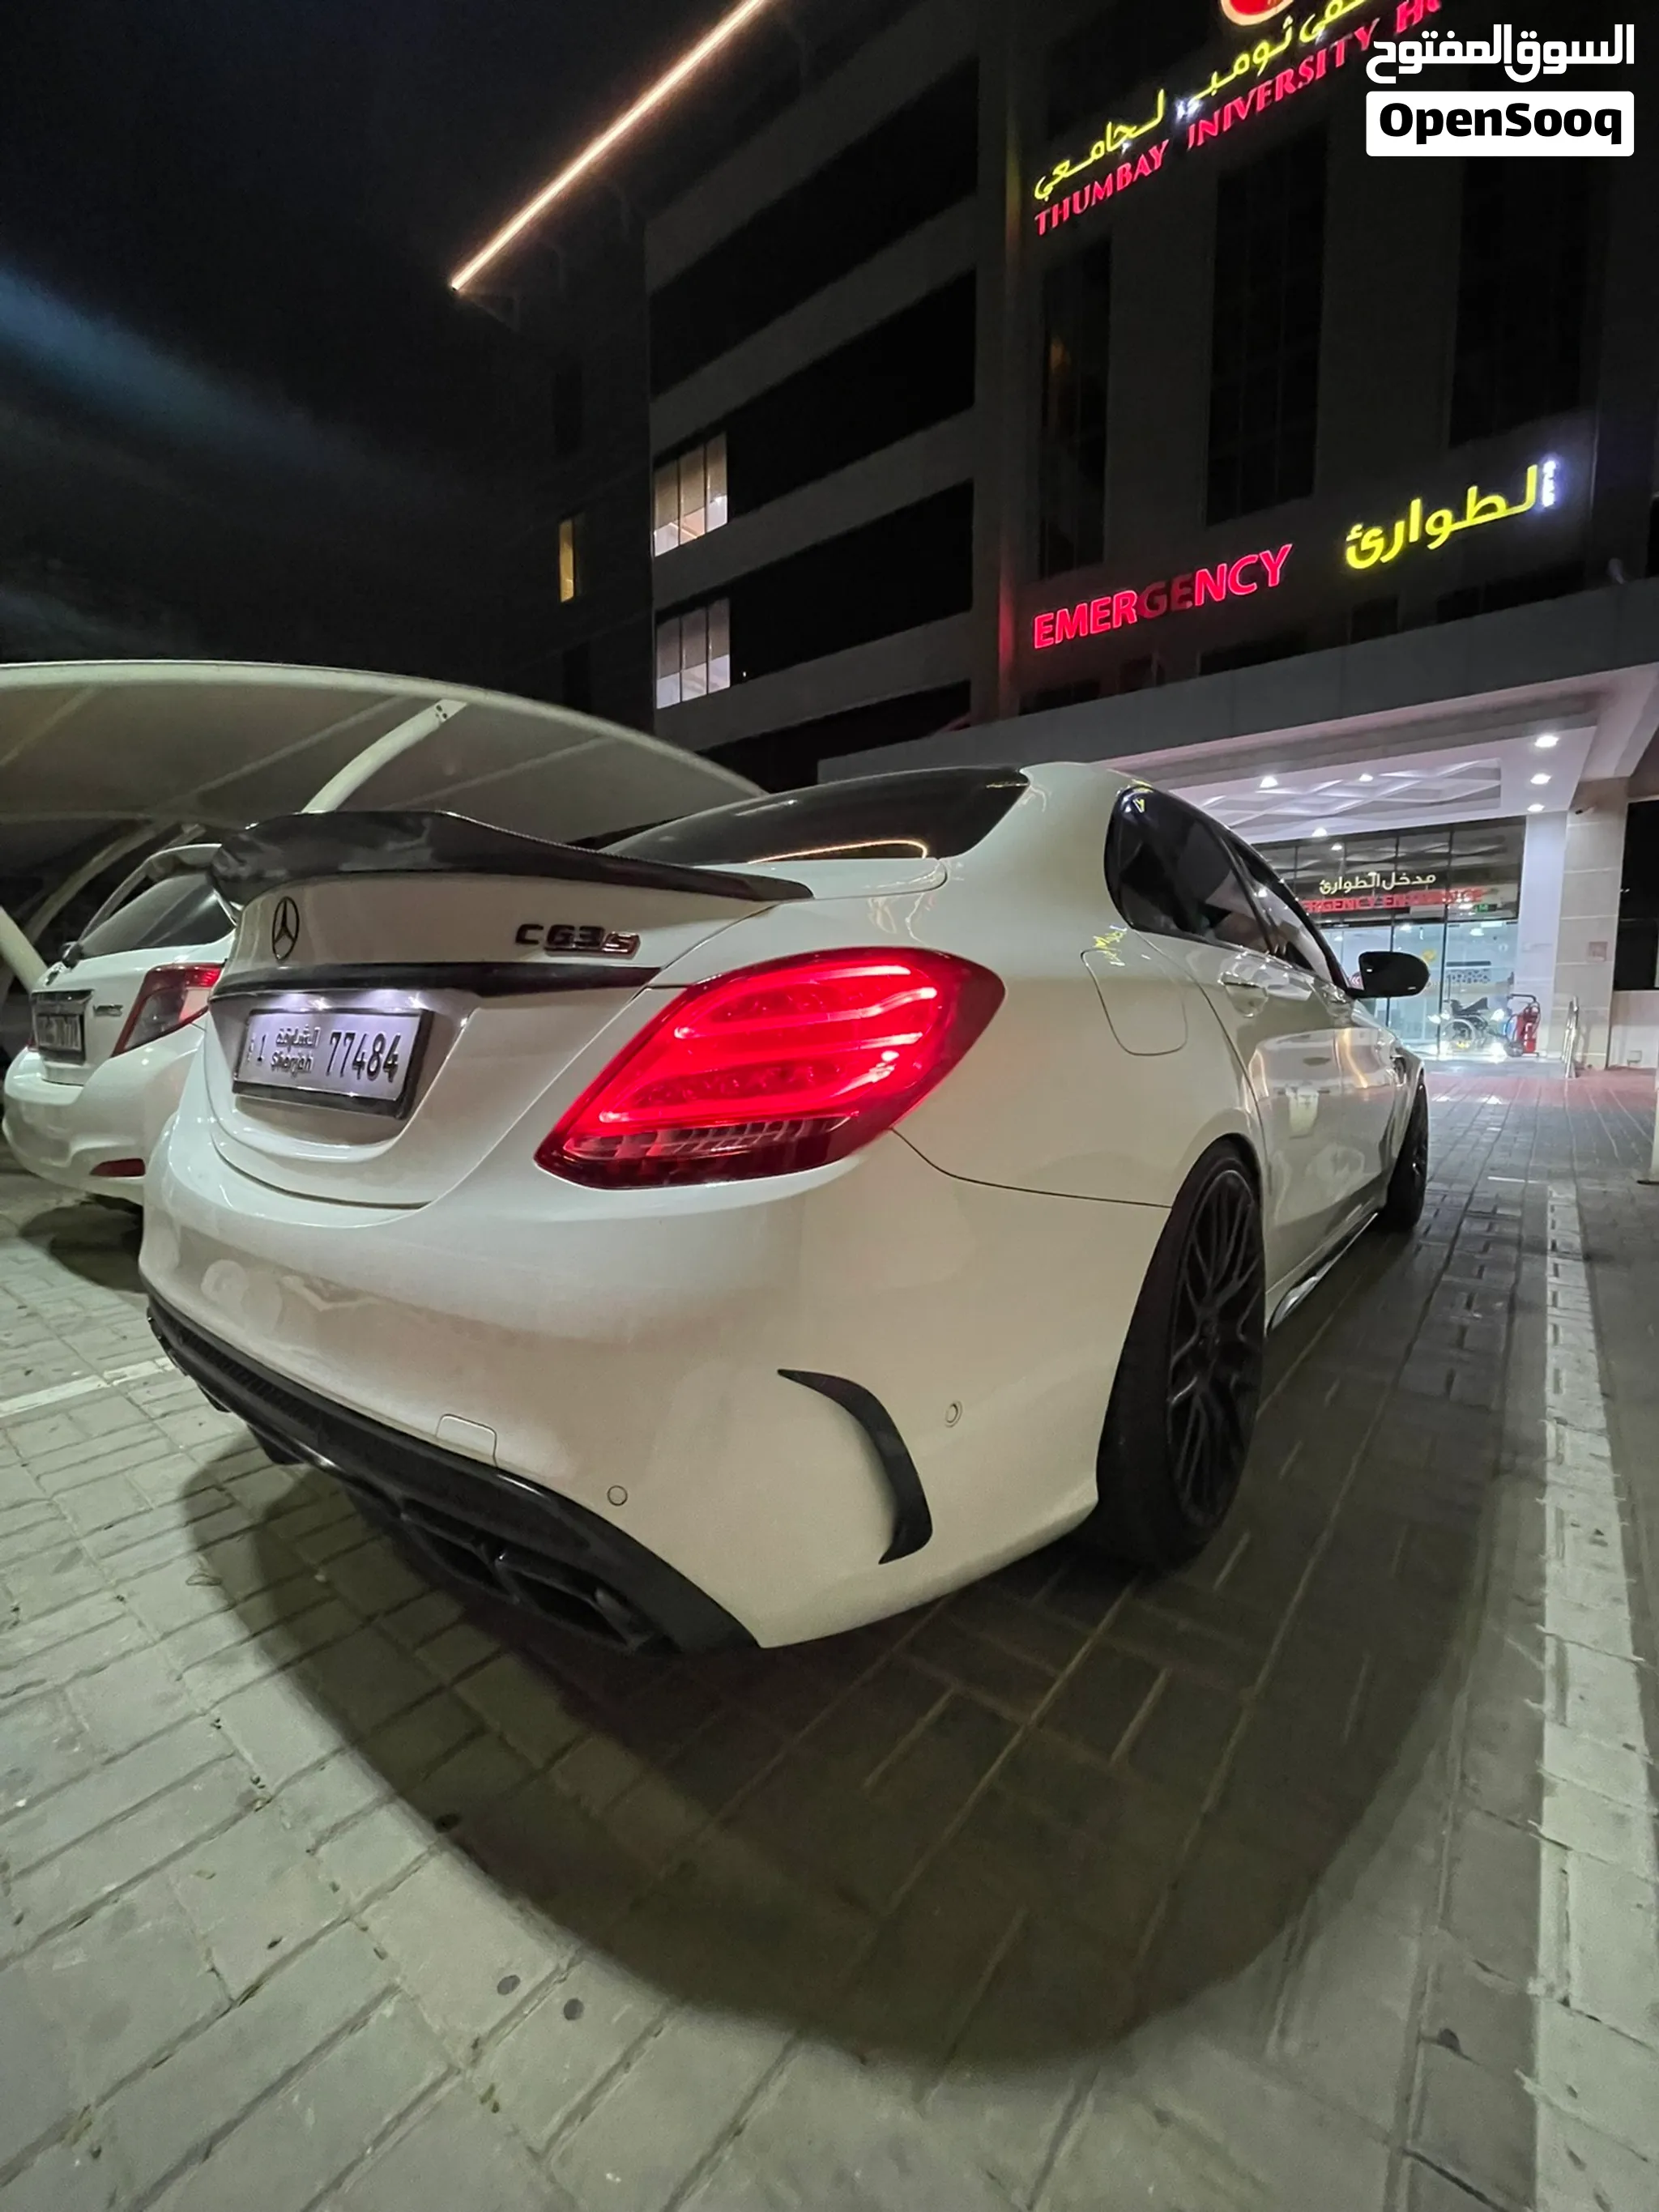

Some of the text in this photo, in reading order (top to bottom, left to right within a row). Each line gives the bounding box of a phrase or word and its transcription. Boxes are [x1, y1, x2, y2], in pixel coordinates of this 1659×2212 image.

[1034, 139, 1170, 236] THUMBAY
[1346, 460, 1556, 569] الطوارئ
[1034, 543, 1293, 649] EMERGENCY
[1319, 872, 1437, 895] مدخل الطوارئ
[326, 1030, 402, 1083] 77484
